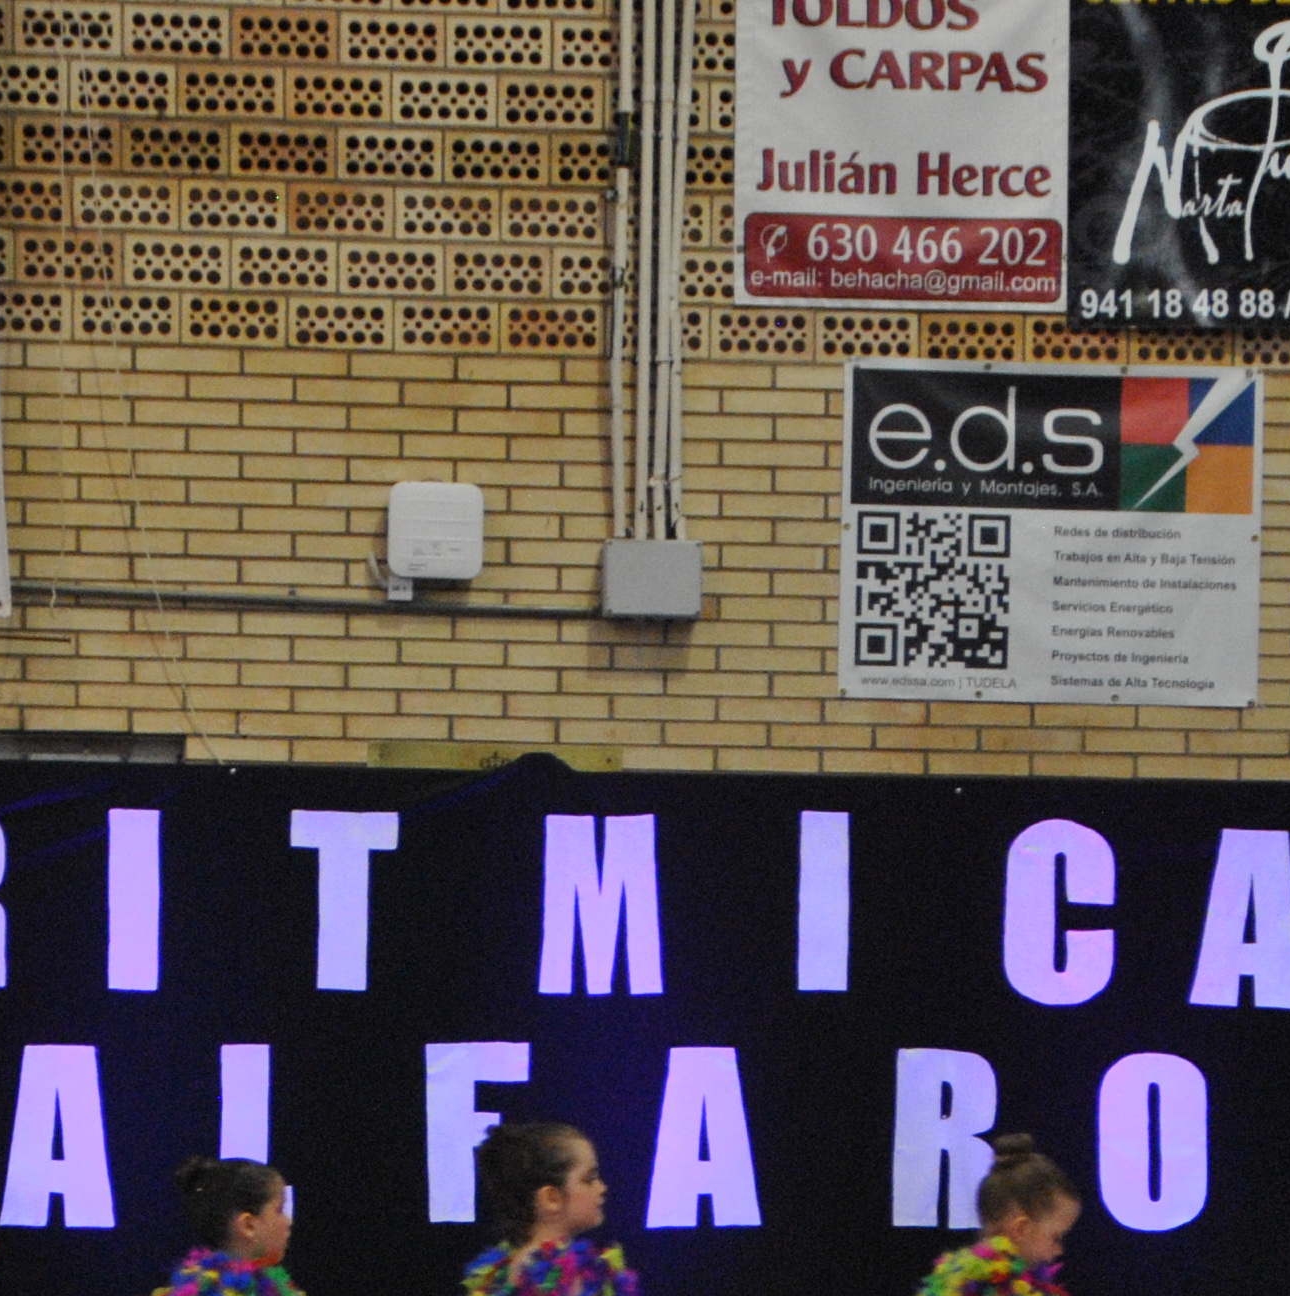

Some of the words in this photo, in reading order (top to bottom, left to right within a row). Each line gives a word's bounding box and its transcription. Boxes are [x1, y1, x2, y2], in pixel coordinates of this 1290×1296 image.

[780, 58, 812, 99] y
[829, 48, 1050, 94] CARPAS
[756, 147, 897, 196] Julián
[917, 151, 1051, 198] Herce
[807, 222, 878, 262] 630
[892, 225, 963, 264] 466
[978, 227, 1047, 266] 202
[750, 270, 822, 288] e-mail:
[830, 269, 1056, 295] behacha@gmail.com
[1080, 288, 1133, 319] 941
[1147, 288, 1183, 319] 18
[1192, 288, 1230, 319] 48
[1239, 288, 1276, 319] 88
[868, 385, 1105, 475] e.d.s
[869, 475, 953, 495] Ingeniería
[961, 481, 972, 496] y
[1071, 481, 1104, 497] S.A.
[1054, 525, 1091, 538] Redes
[1094, 526, 1108, 538] de
[1111, 526, 1181, 541] distribución
[1054, 550, 1104, 565] Trabajos
[1106, 554, 1121, 564] en
[1123, 552, 1147, 564] Alta
[1160, 552, 1187, 567] Baja
[1191, 553, 1236, 566] Tensión
[1052, 575, 1140, 589] Mantenimiento
[1142, 576, 1157, 588] de
[1160, 577, 1237, 591] Instalaciones
[1051, 600, 1107, 613] Servicios
[1109, 601, 1174, 616] Energético
[1106, 626, 1176, 639] Renovables
[1051, 650, 1110, 664] Proyectos
[1114, 651, 1128, 663] de
[966, 676, 1017, 690] TUDELA
[1050, 675, 1104, 687] Sistemas
[1107, 676, 1122, 687] de
[1124, 677, 1148, 688] Alta
